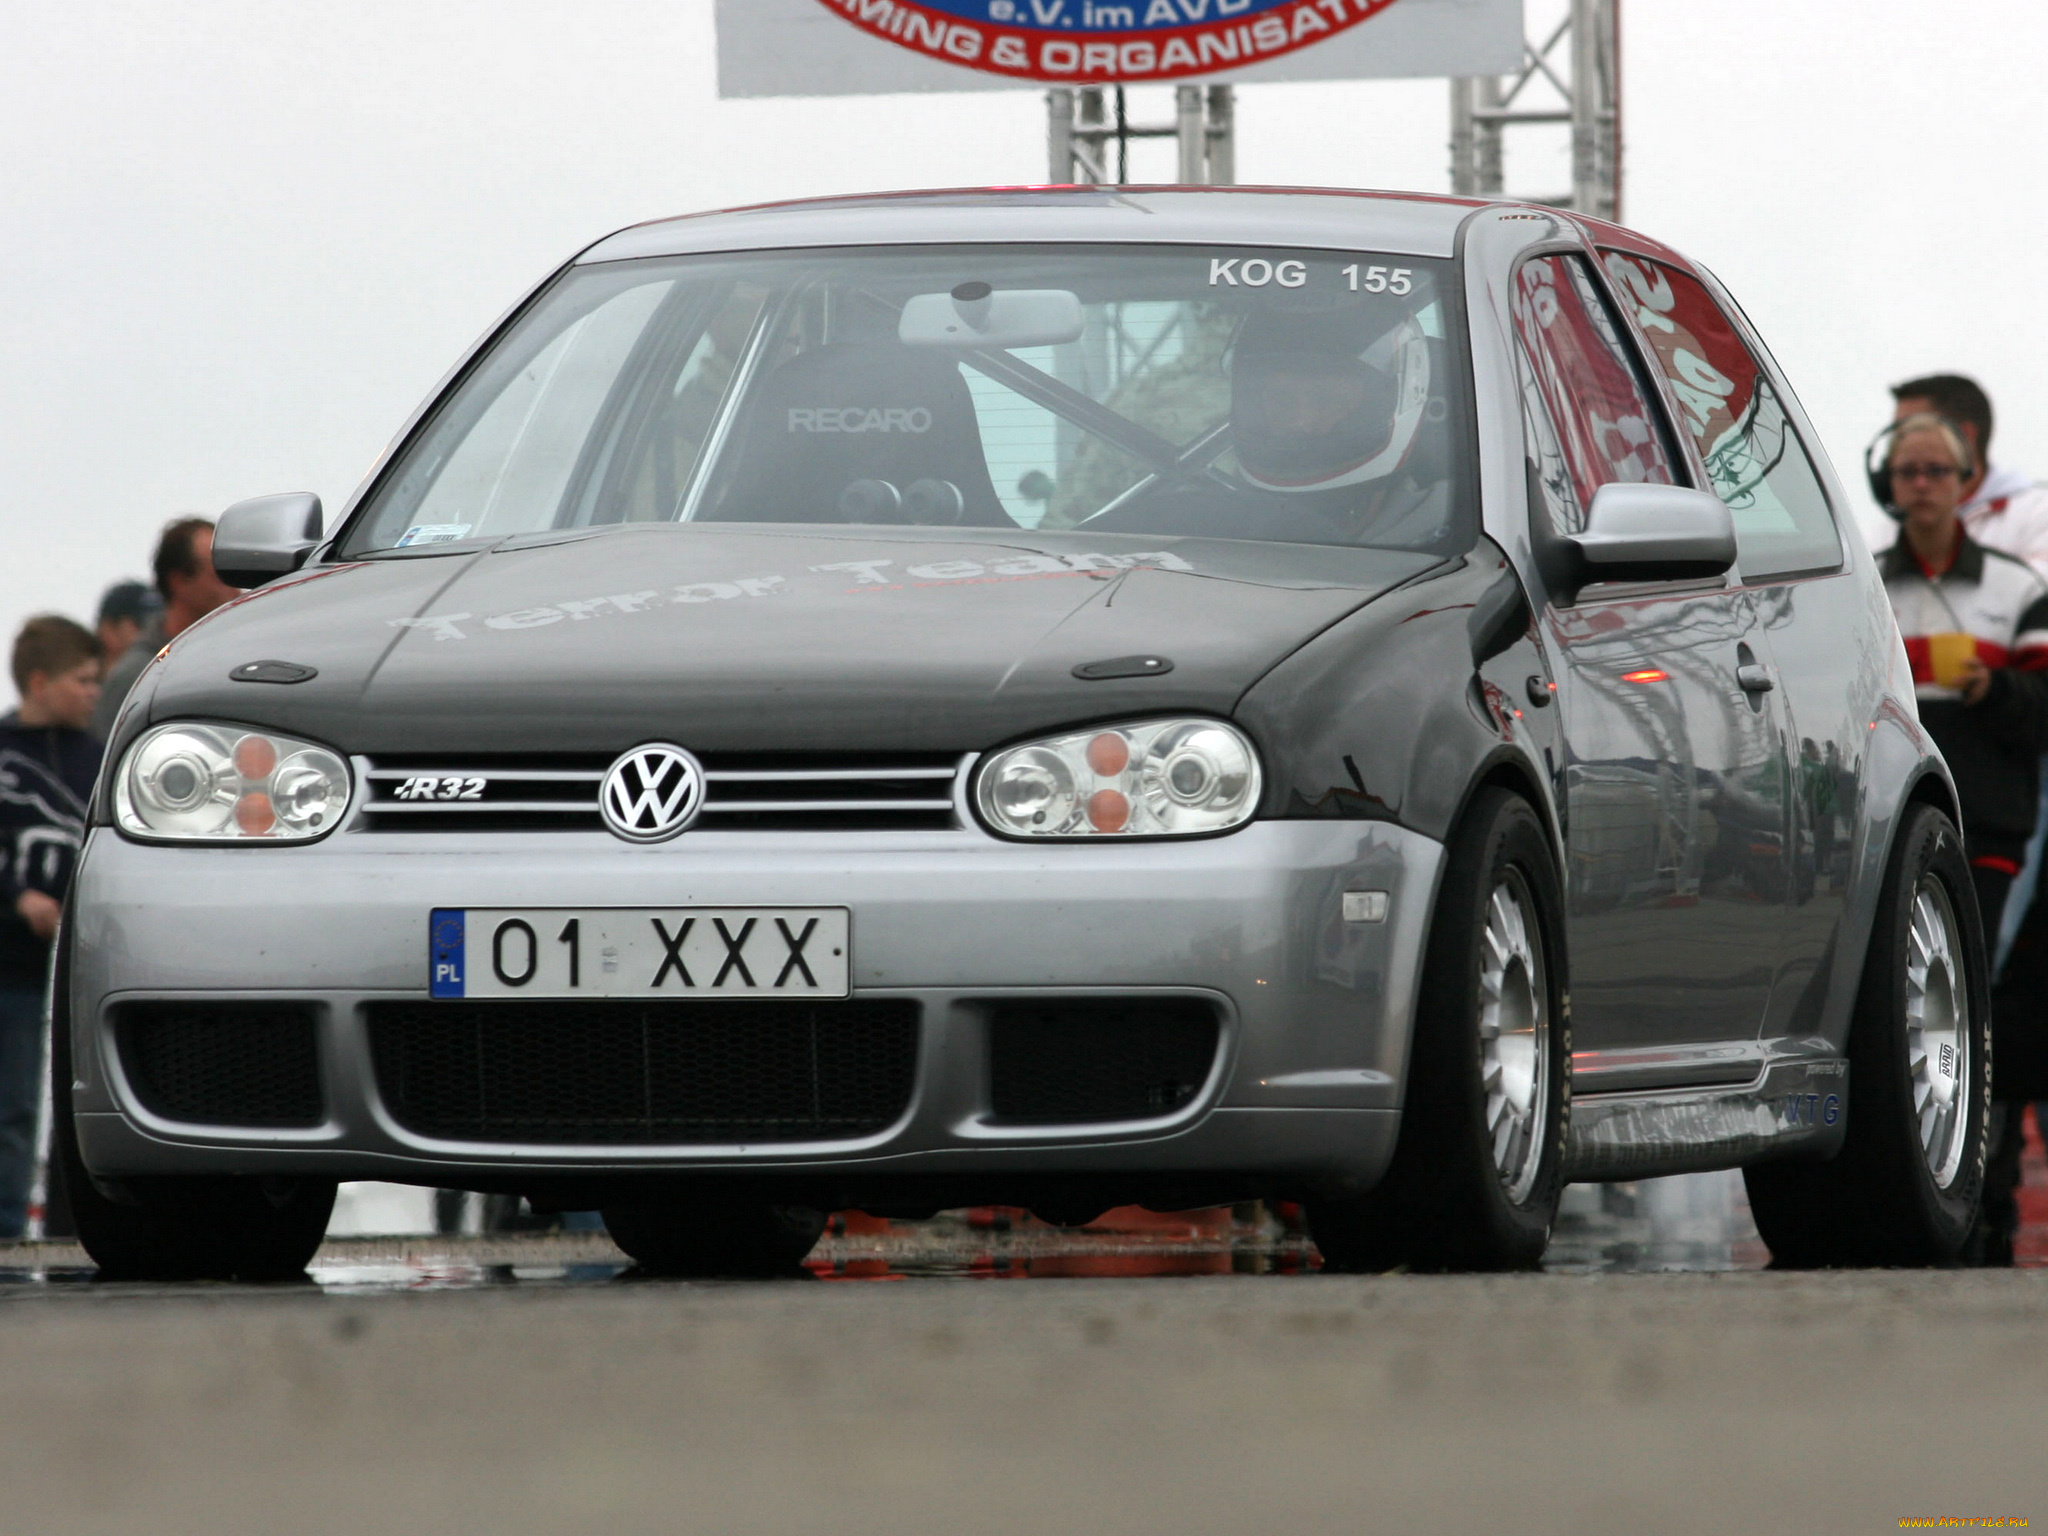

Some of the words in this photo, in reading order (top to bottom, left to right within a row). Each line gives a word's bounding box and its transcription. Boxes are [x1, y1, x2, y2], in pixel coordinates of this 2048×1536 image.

[1084, 0, 1134, 28] im
[989, 36, 1030, 69] &
[1208, 258, 1307, 288] KOG
[1341, 264, 1412, 296] 155
[788, 406, 932, 434] RECARO
[387, 574, 786, 641] Terror
[807, 551, 1194, 584] Team
[650, 917, 819, 988] XXX
[436, 964, 461, 983] PL
[1941, 1044, 1953, 1077] BRAID
